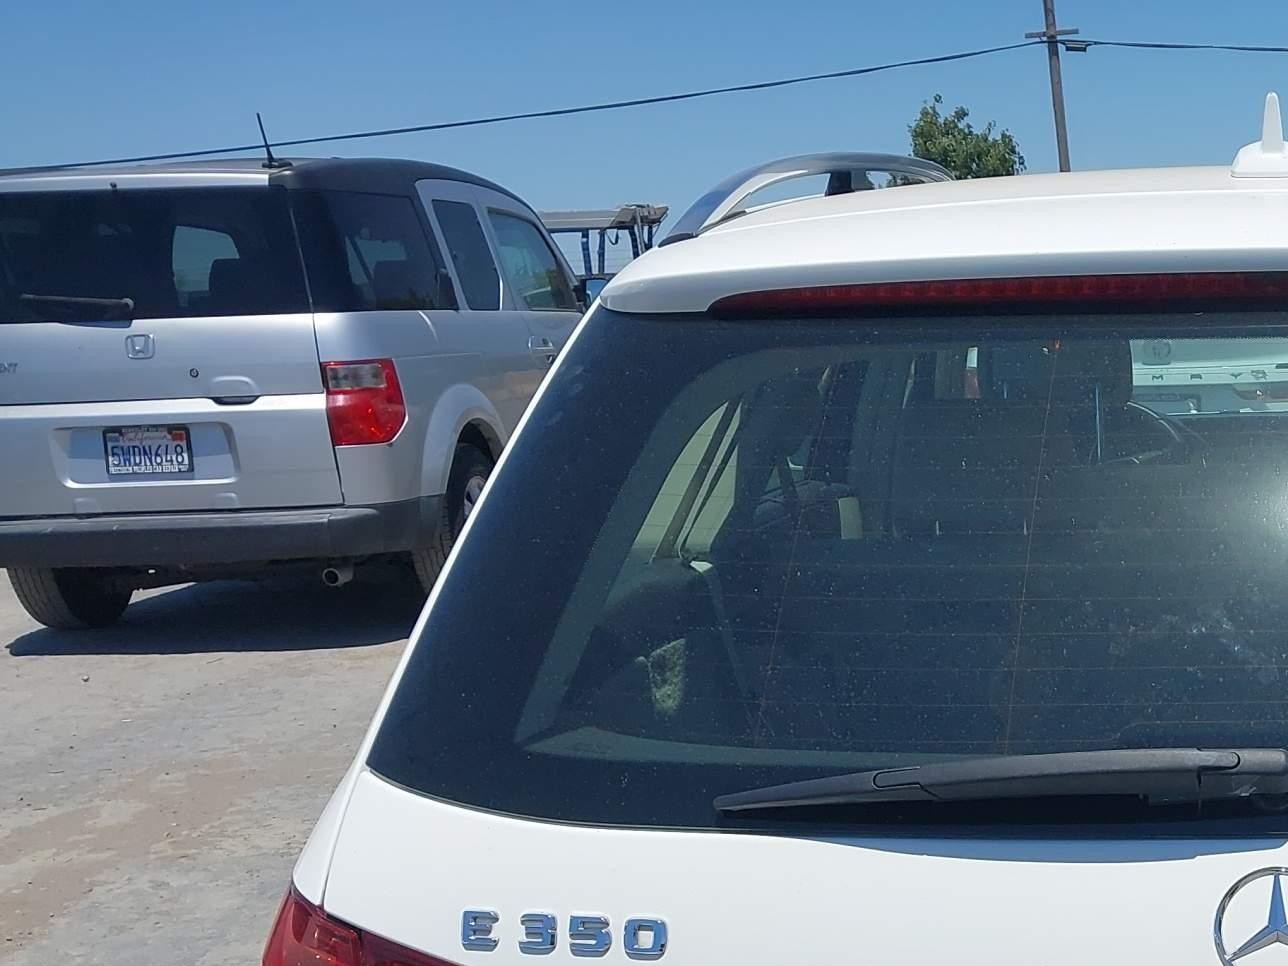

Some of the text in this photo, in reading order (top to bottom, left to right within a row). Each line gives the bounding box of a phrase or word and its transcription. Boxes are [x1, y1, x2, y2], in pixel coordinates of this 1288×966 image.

[111, 443, 185, 467] 5WDN648
[460, 910, 668, 961] E 350
